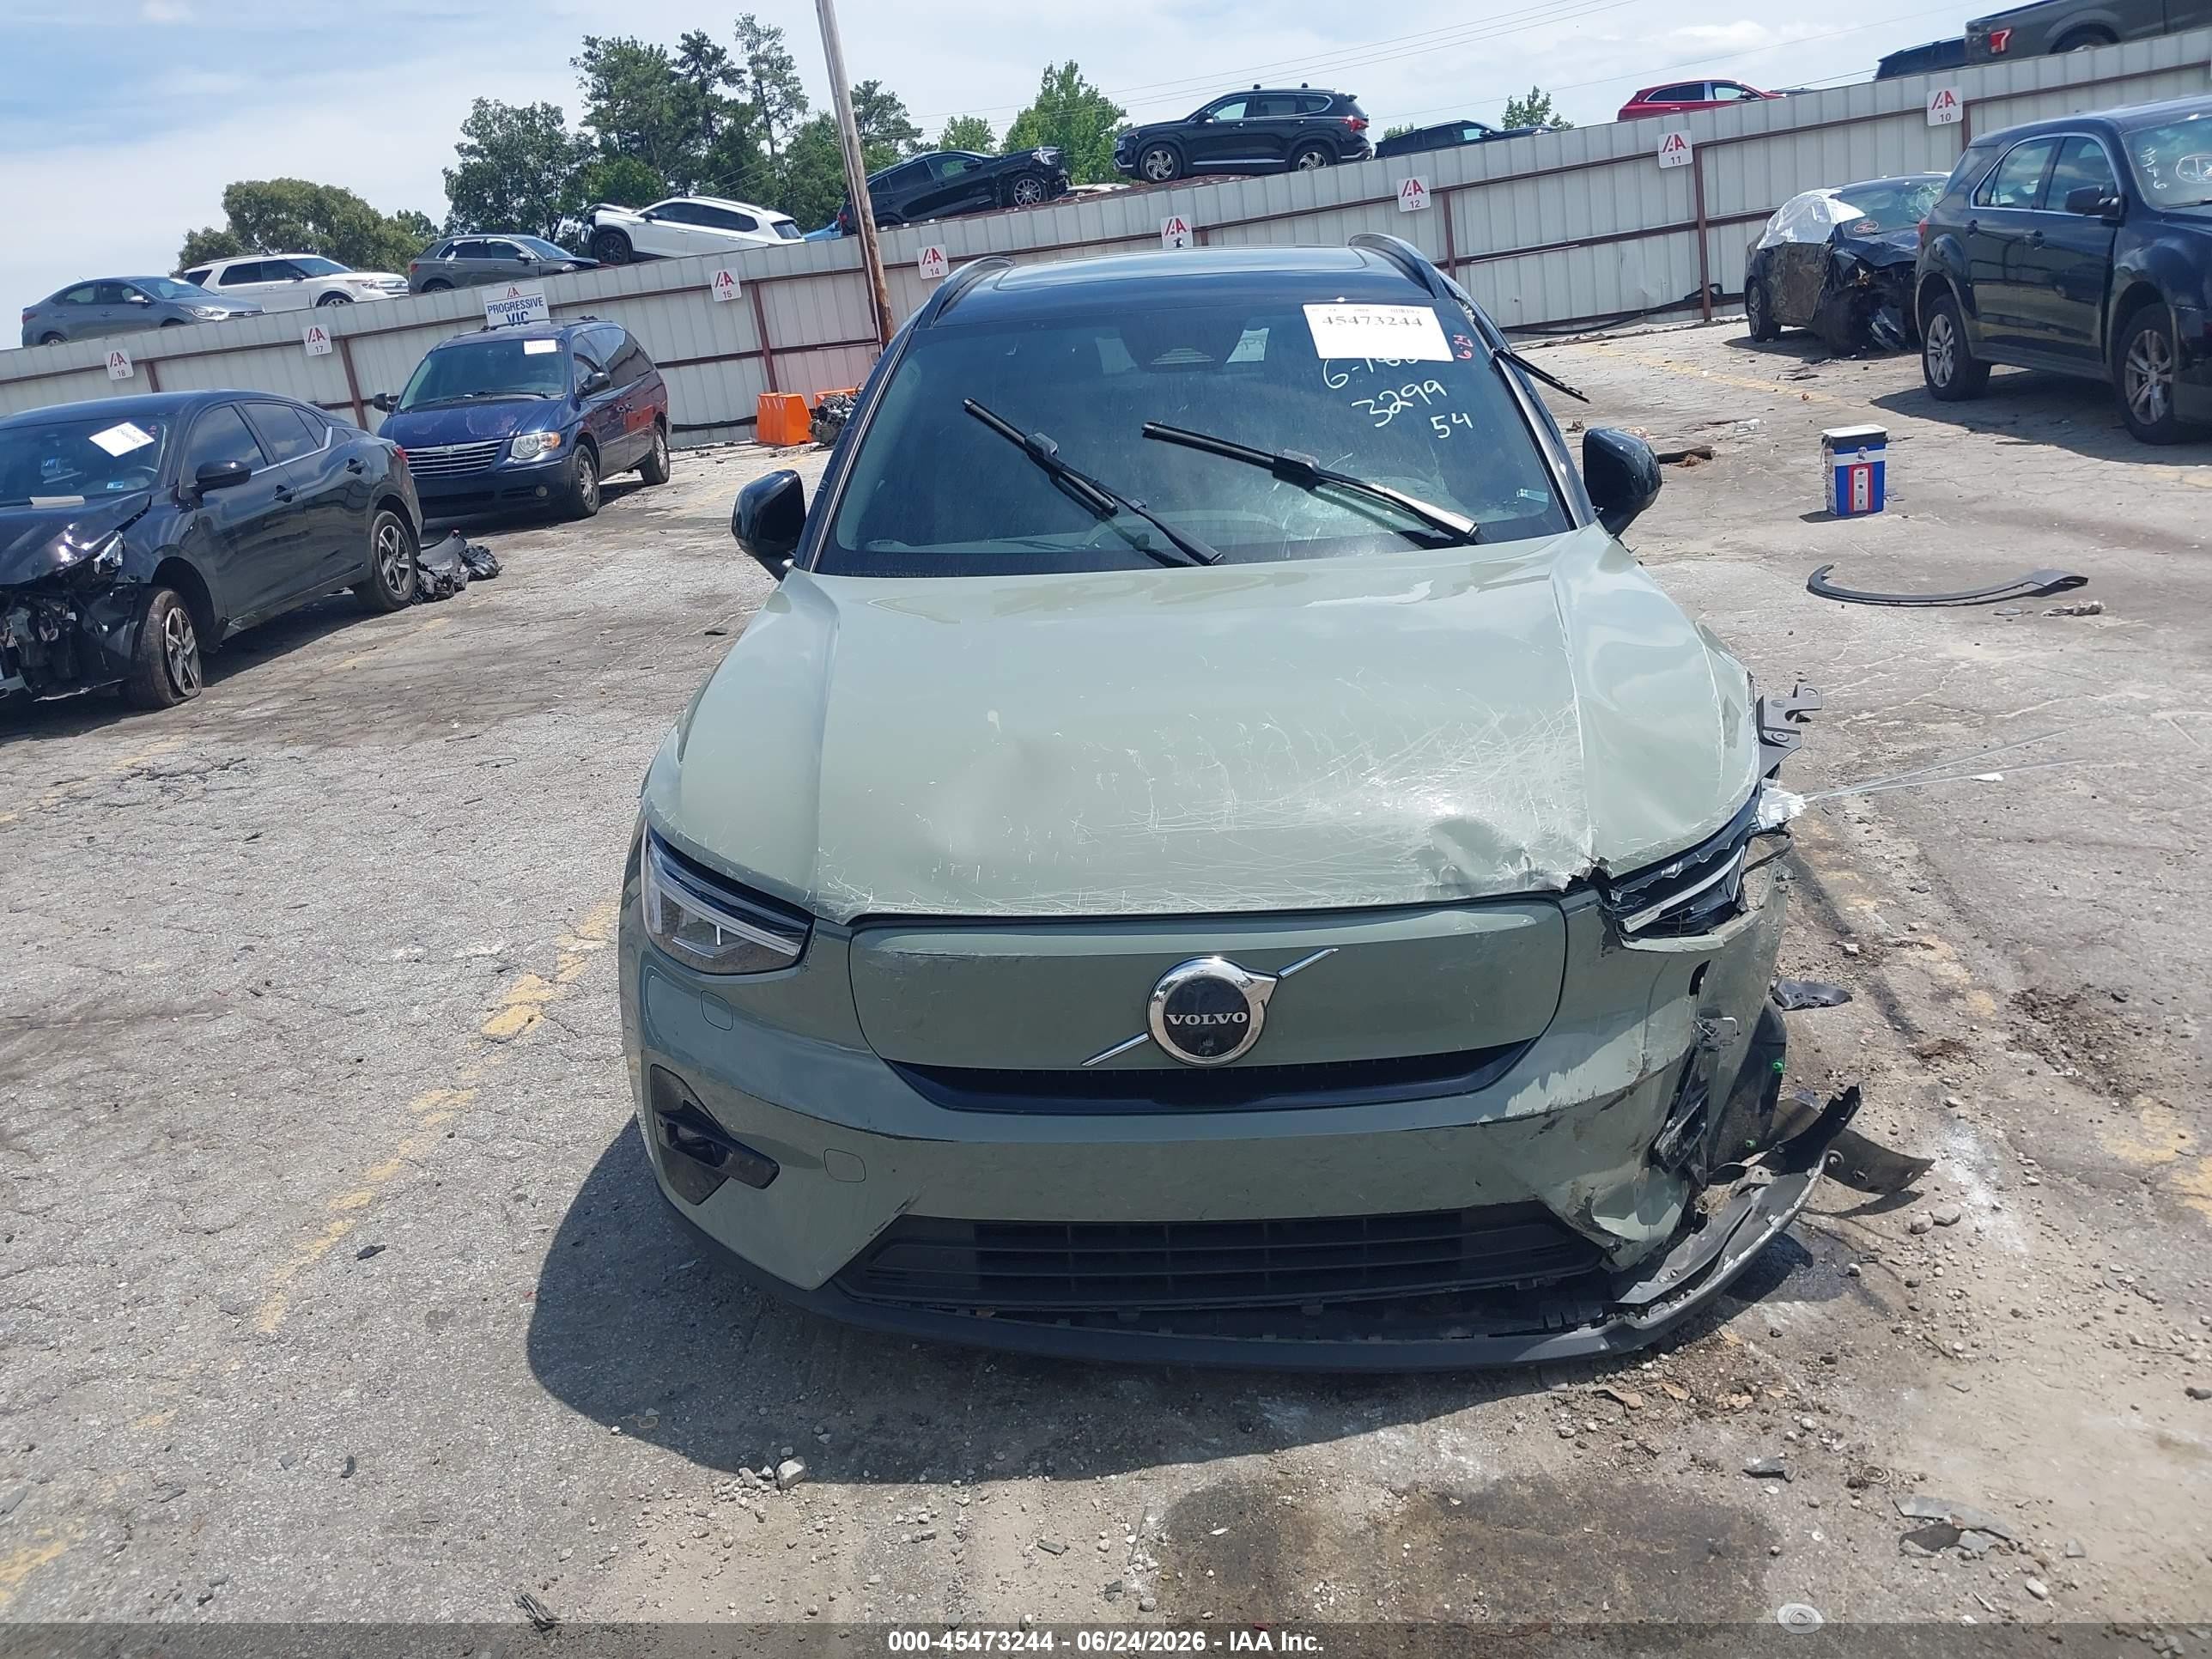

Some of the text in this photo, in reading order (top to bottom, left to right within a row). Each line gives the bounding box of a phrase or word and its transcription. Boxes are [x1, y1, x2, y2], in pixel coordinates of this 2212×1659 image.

[1940, 112, 1951, 122] 10
[1670, 155, 1681, 165] 11
[1409, 199, 1421, 209] 12
[722, 289, 732, 299] 15
[487, 296, 544, 315] PROGRESSIVE
[506, 311, 530, 327] VIC
[1322, 315, 1423, 327] 45473244
[315, 345, 324, 354] 17
[117, 369, 126, 378] 18
[1351, 380, 1448, 428] 3299
[1430, 412, 1474, 439] 54
[1166, 1012, 1248, 1025] VOLVO
